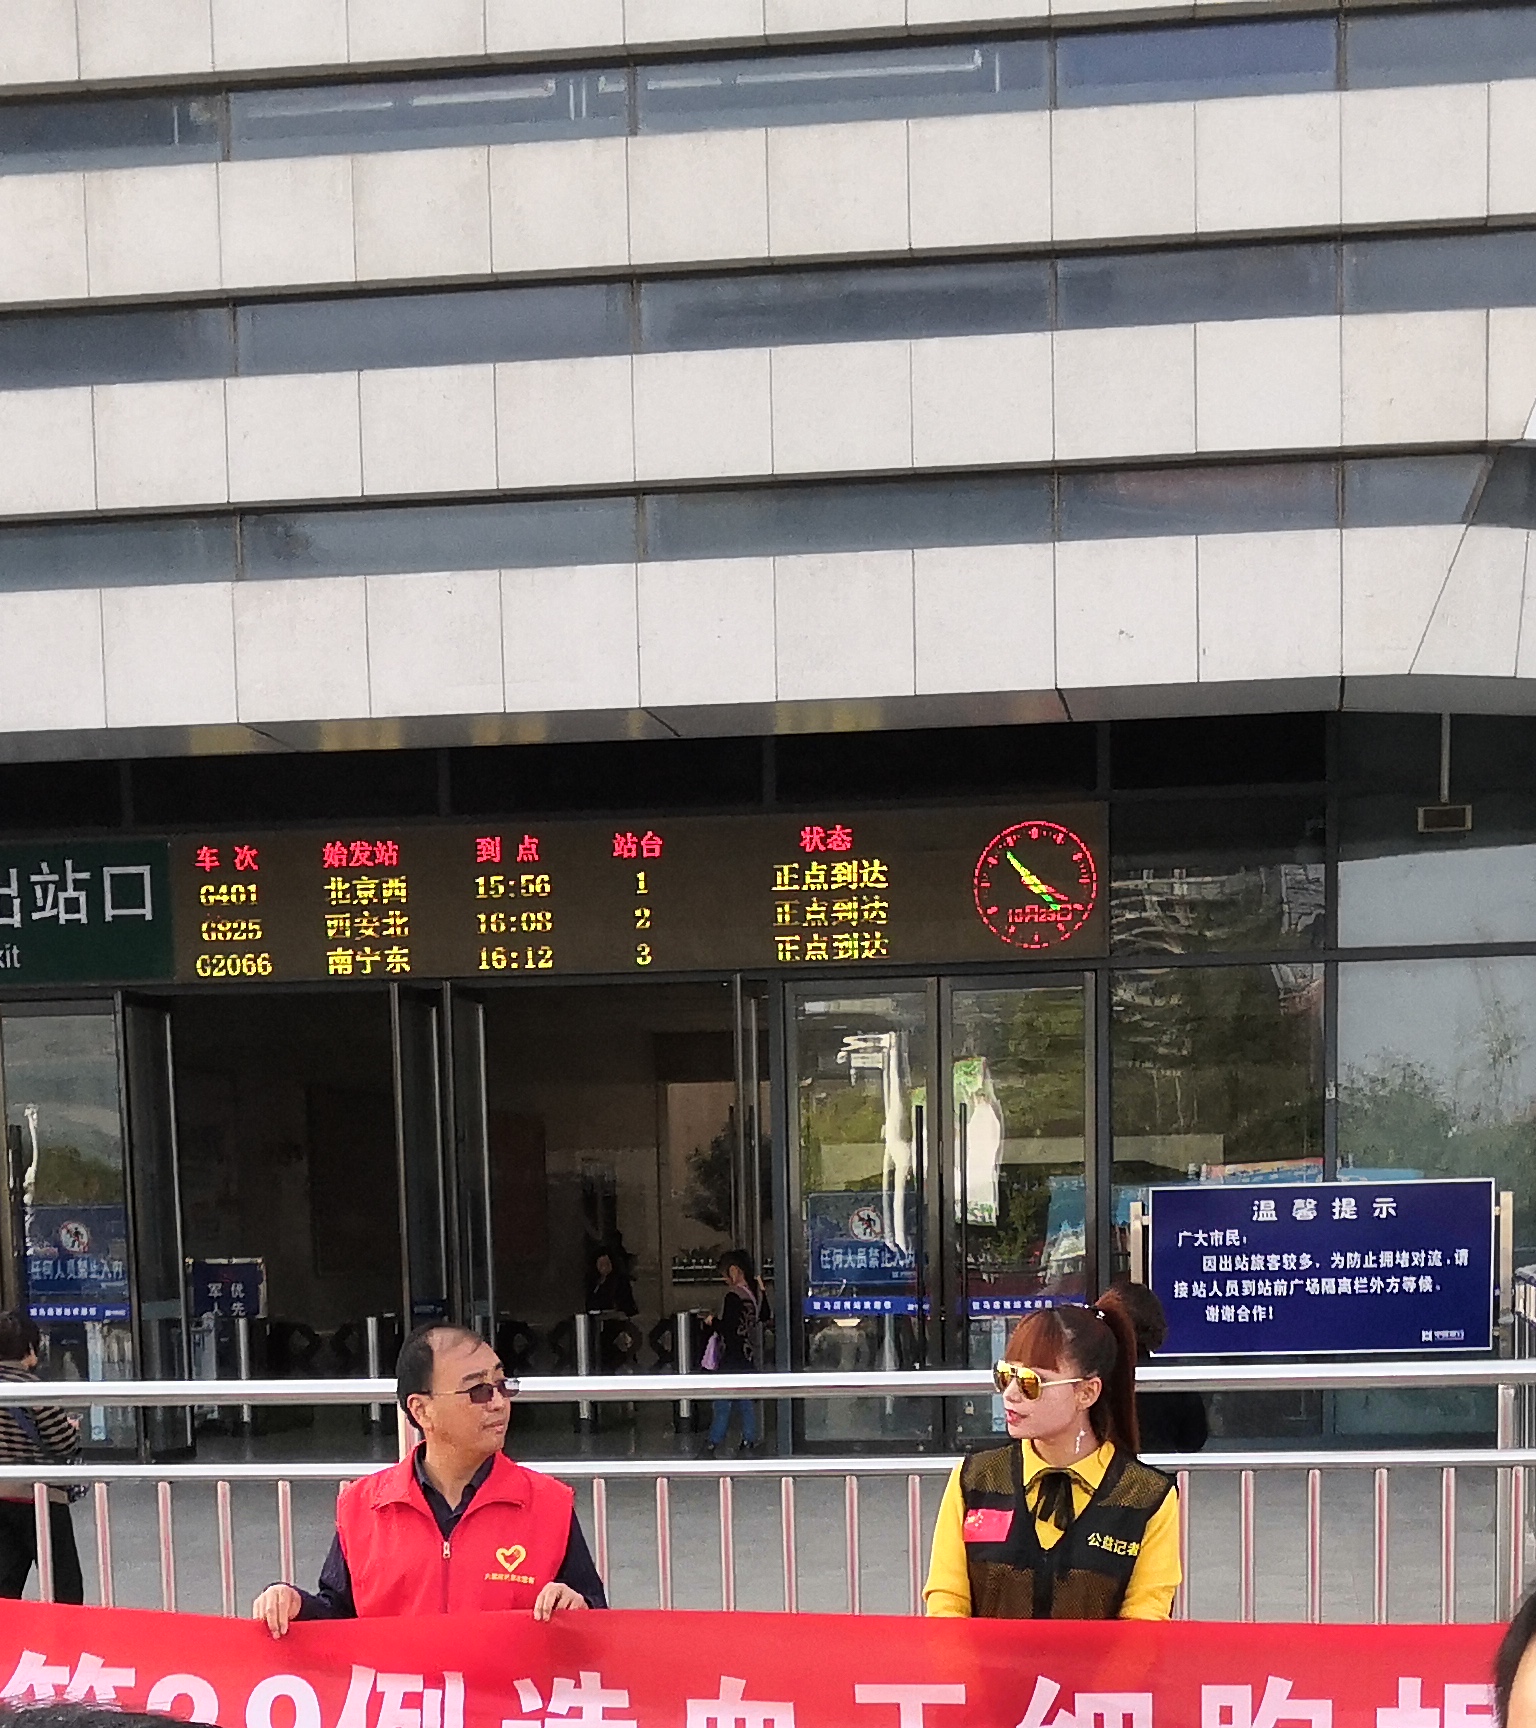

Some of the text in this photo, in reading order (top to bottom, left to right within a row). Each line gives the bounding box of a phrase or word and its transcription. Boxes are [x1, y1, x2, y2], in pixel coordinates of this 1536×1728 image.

[195, 824, 854, 872] 车次 始发站 到点 站台 状态
[199, 858, 890, 906] G401 北京西 15:56 1 正点到达
[325, 911, 410, 942] 西安北
[476, 911, 553, 935] 16:08
[634, 907, 652, 930] 2
[772, 894, 890, 928] 正点到达
[196, 932, 890, 979] G2066 南宁东 16:12 3 正点到达
[1252, 1197, 1398, 1222] 温馨提示
[1086, 1531, 1141, 1557] 公益记者
